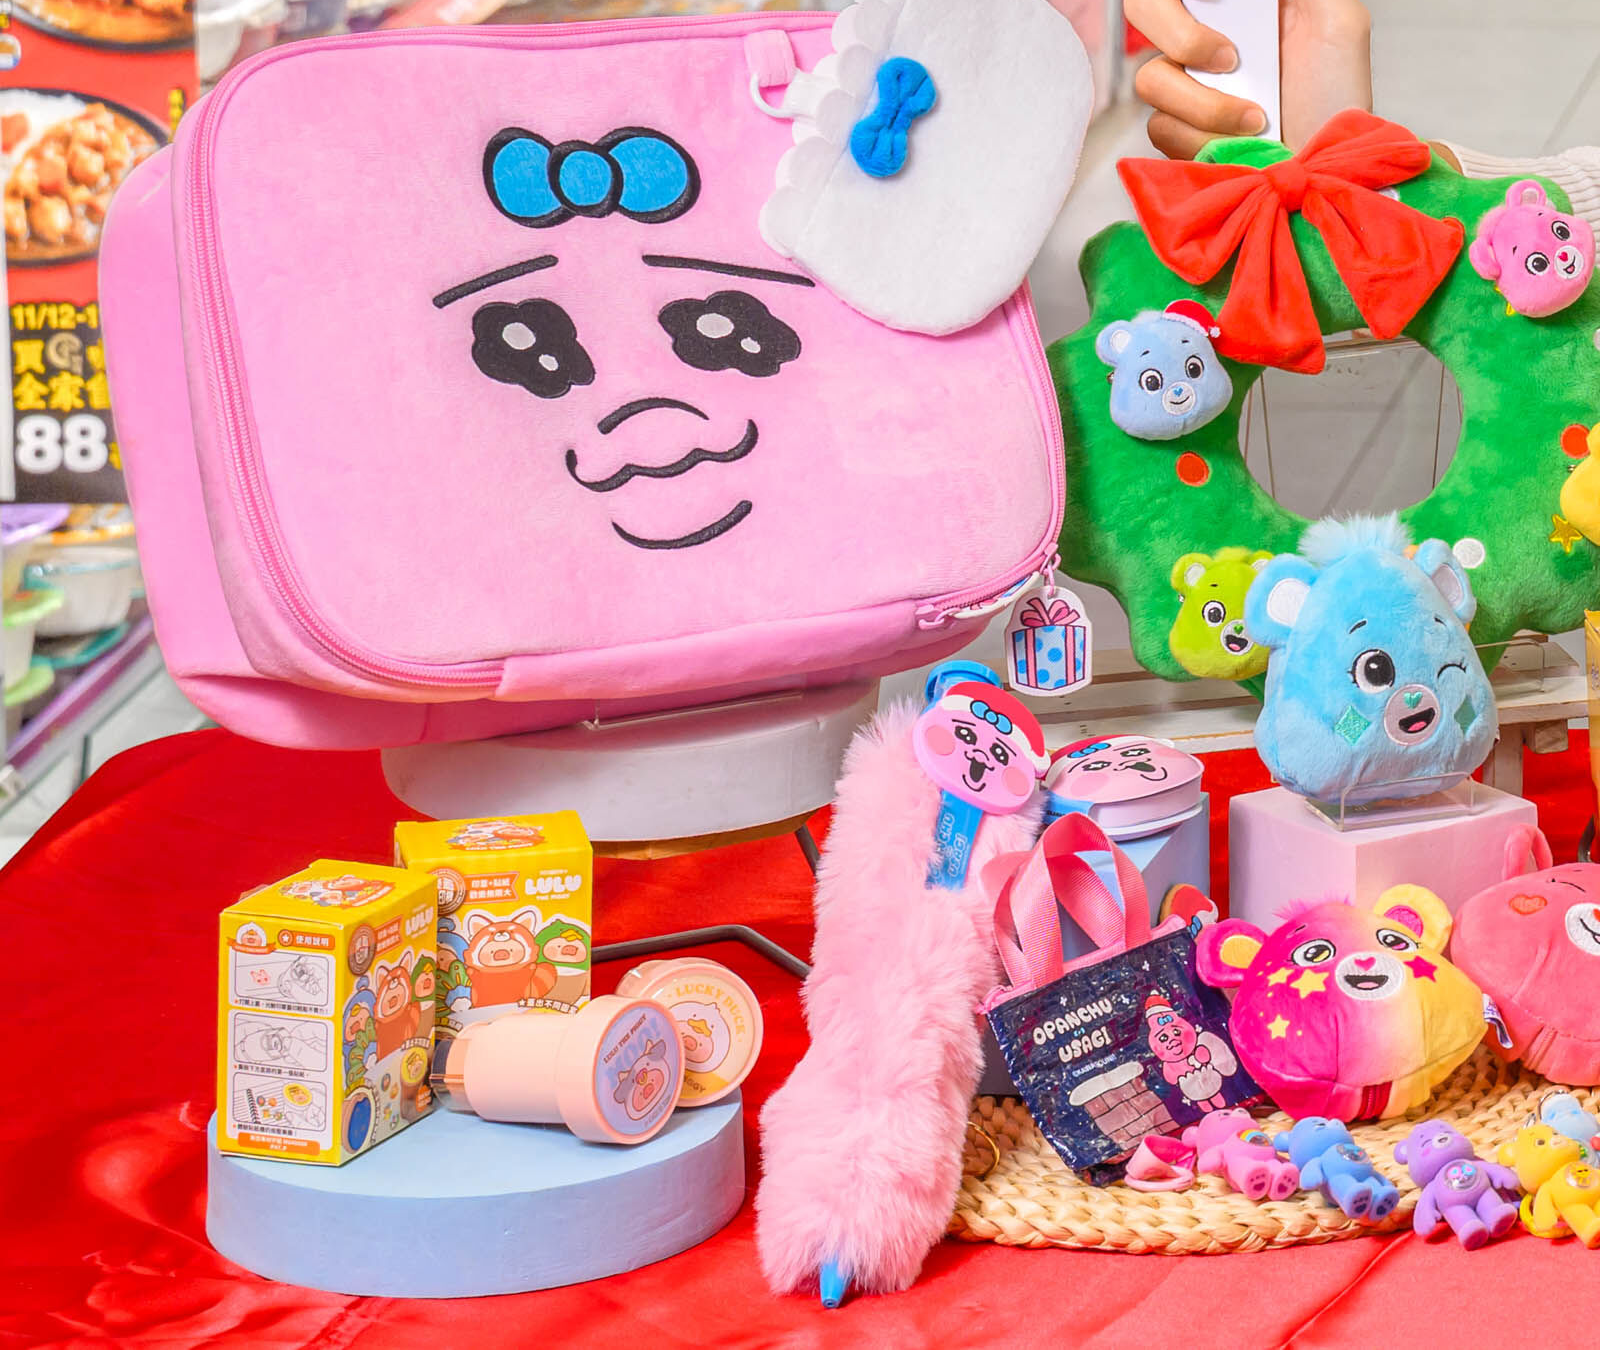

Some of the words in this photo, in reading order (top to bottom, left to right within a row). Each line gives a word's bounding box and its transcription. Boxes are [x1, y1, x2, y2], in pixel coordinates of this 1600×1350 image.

[17, 414, 109, 475] 88
[524, 874, 582, 895] LULU
[675, 984, 725, 999] LUCKY
[722, 996, 746, 1035] DUCK
[1032, 998, 1113, 1046] OPANCHU
[1058, 1025, 1112, 1063] USAGI
